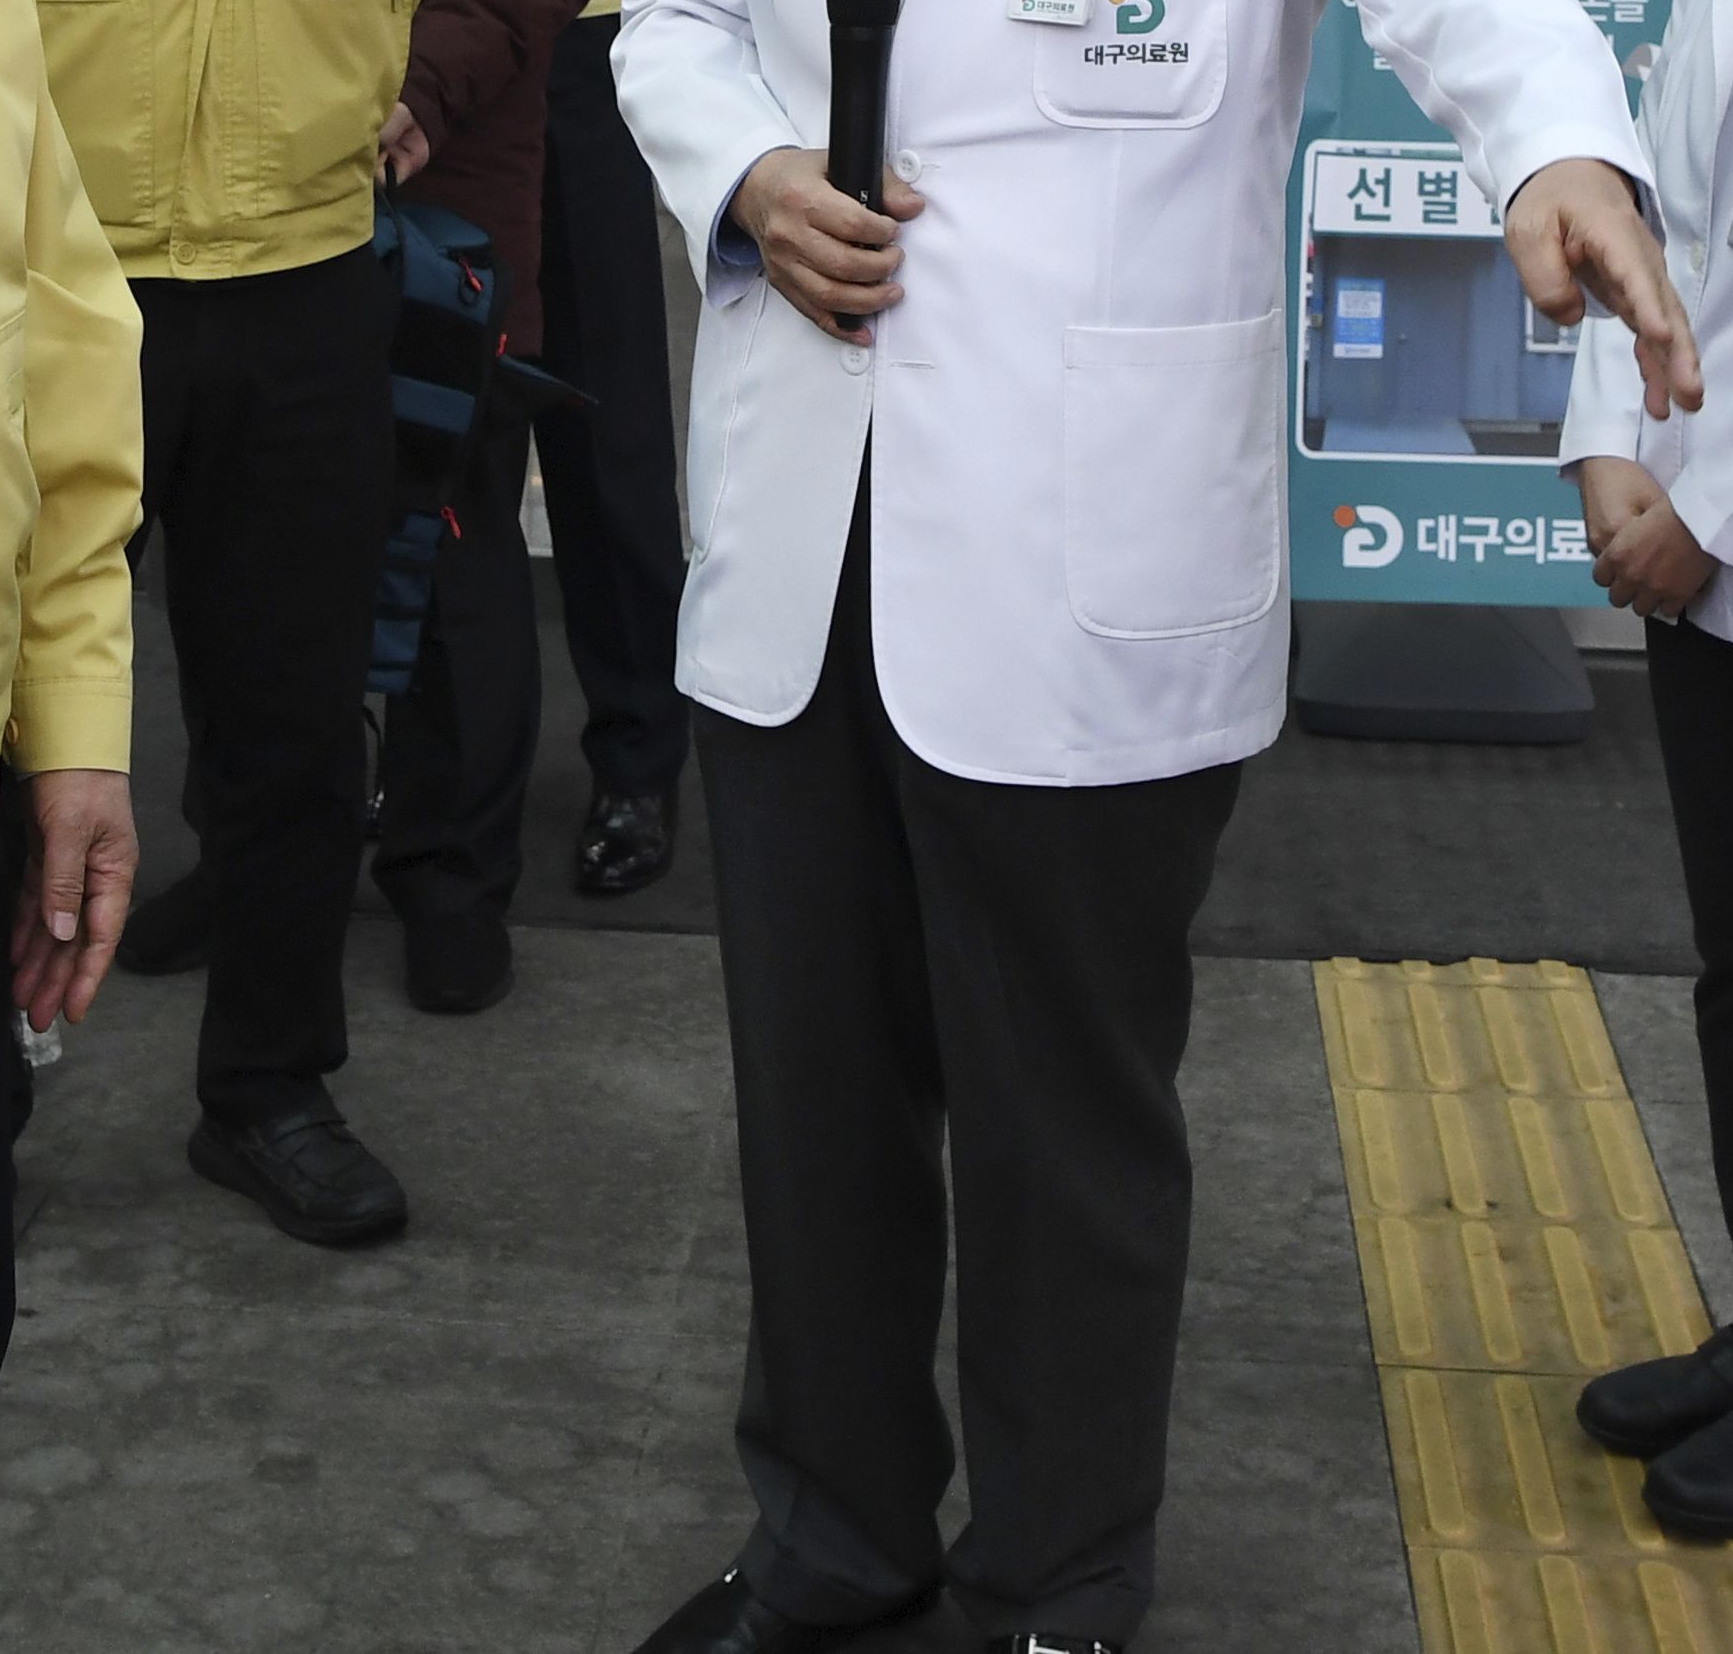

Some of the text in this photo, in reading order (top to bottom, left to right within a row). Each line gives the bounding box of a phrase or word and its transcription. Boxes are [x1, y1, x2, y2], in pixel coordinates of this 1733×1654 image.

[1037, 0, 1075, 13] 대구의료원
[1084, 43, 1189, 66] 대구의료원
[1347, 168, 1500, 224] 선별
